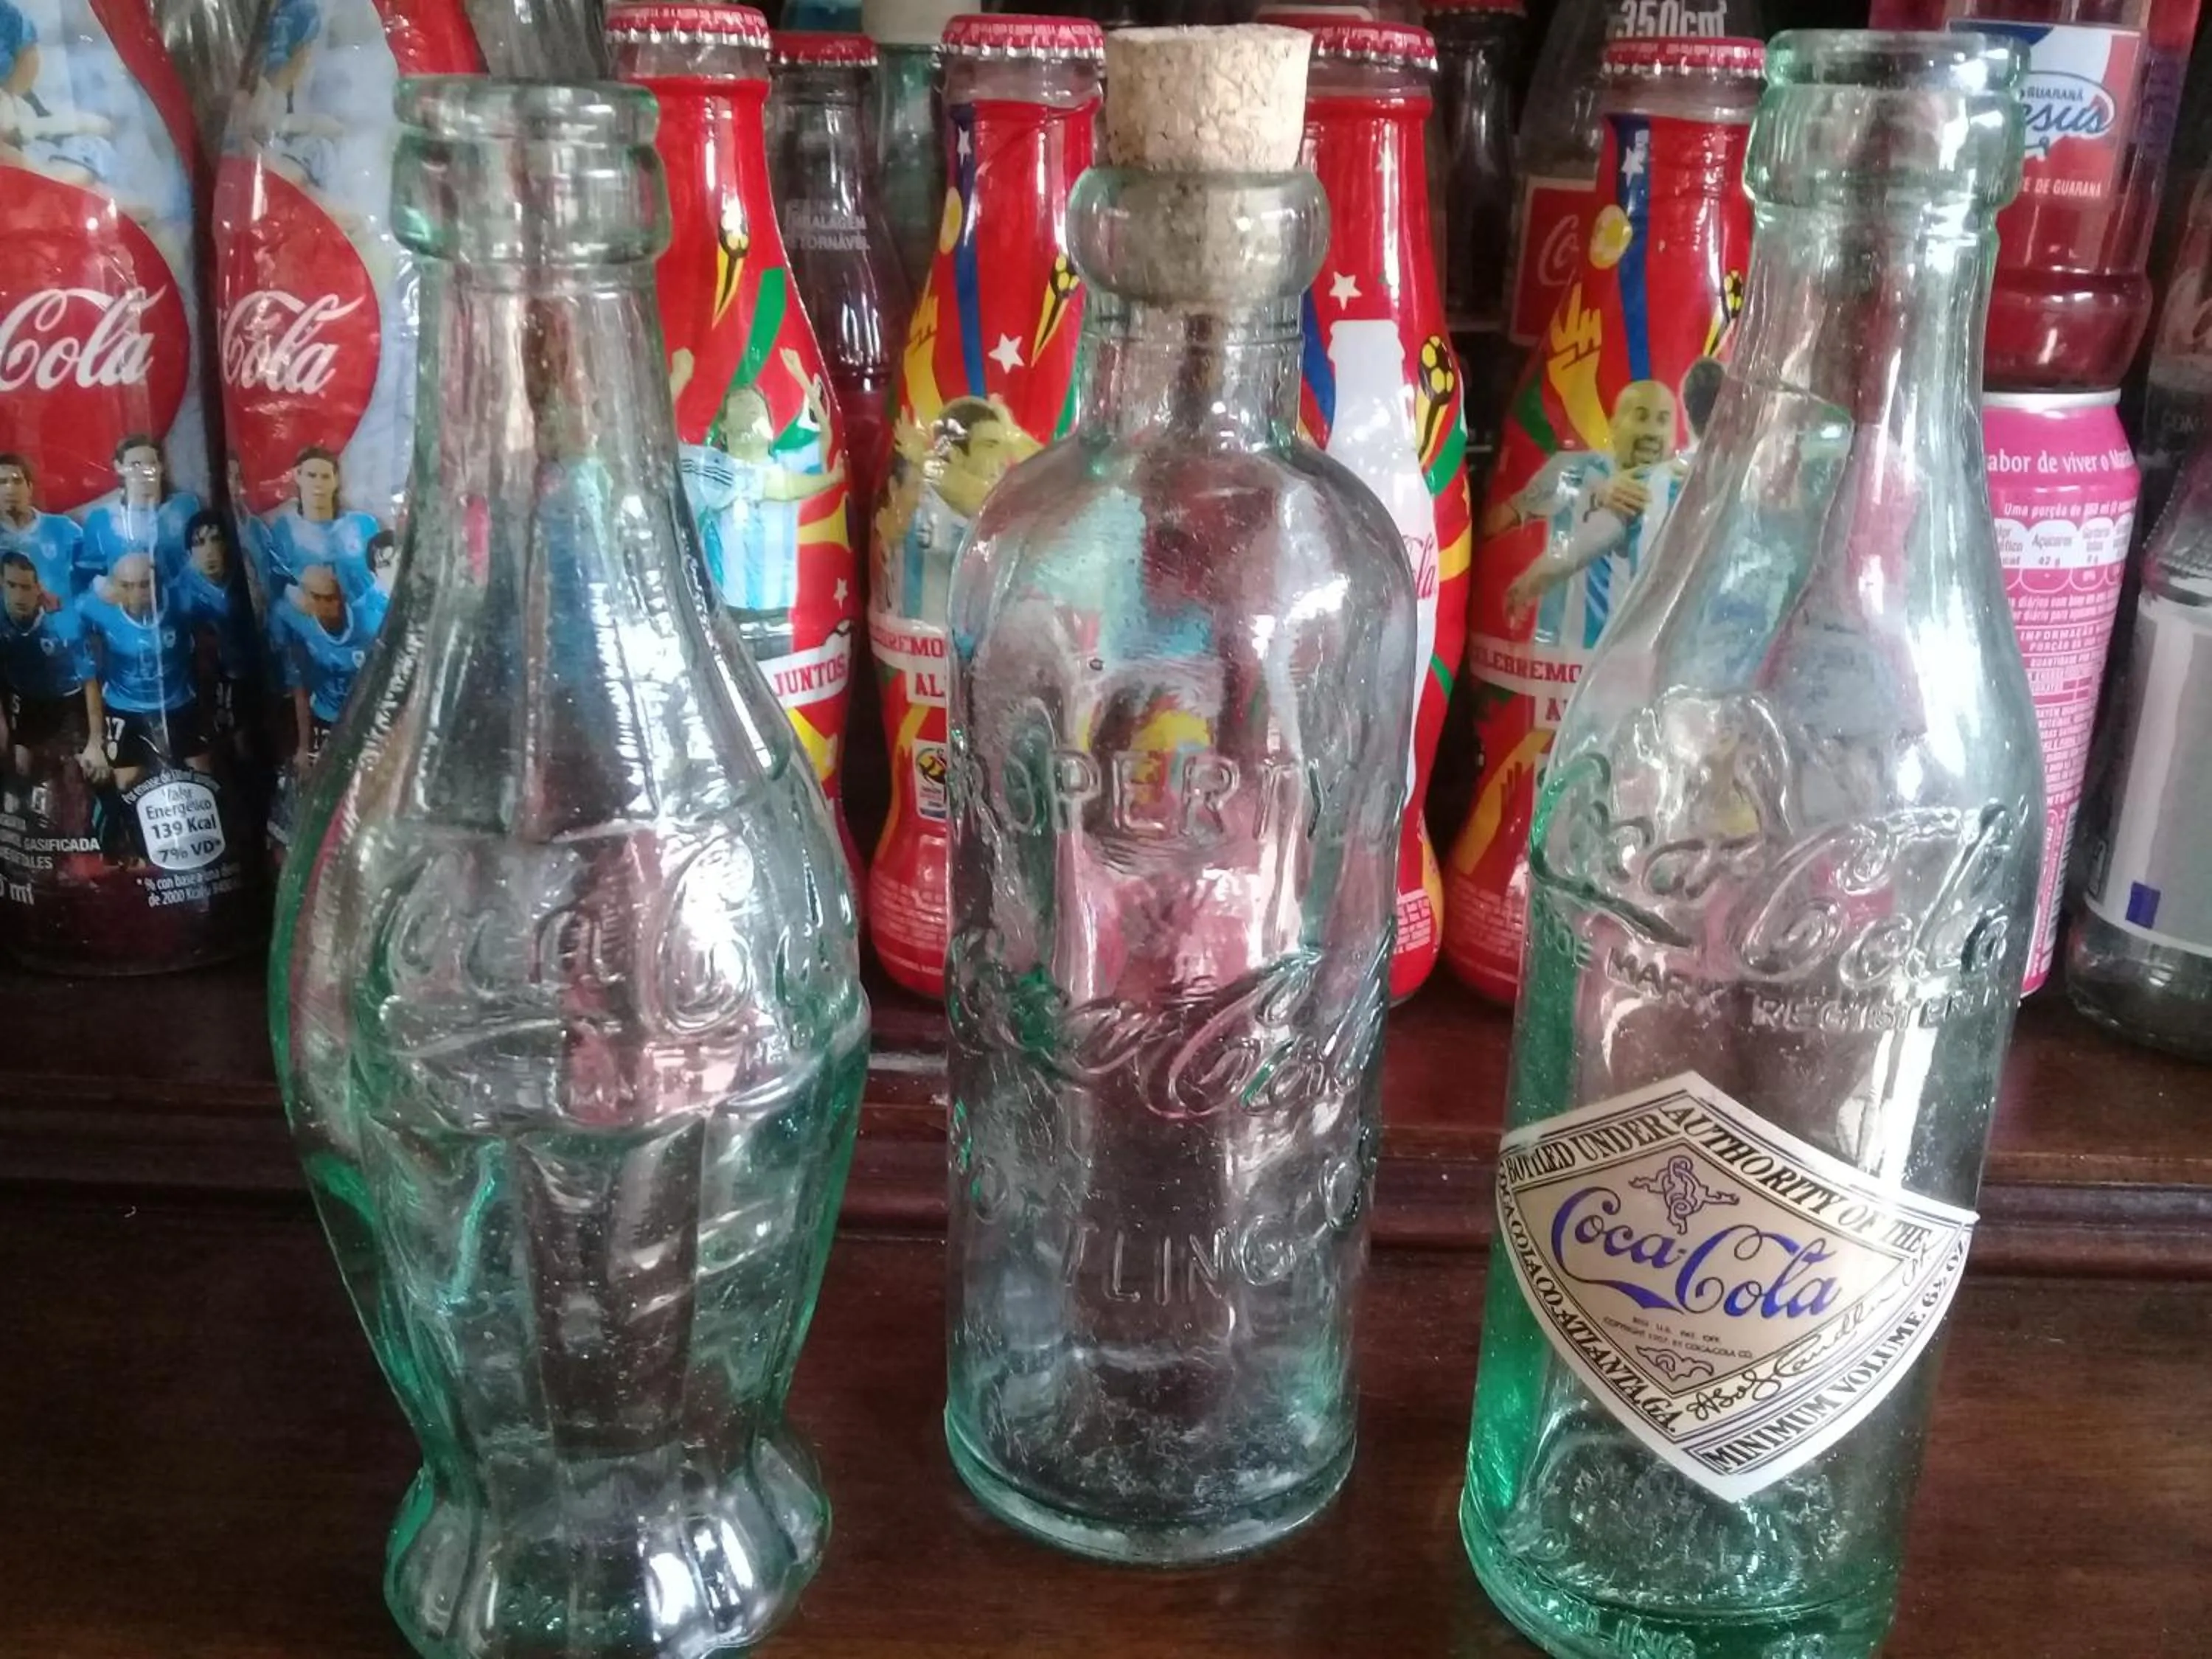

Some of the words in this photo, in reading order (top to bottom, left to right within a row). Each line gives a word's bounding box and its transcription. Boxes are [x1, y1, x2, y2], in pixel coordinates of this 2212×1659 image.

[2023, 103, 2115, 135] esus
[1986, 448, 2031, 473] abor
[2037, 449, 2059, 473] de
[2062, 451, 2098, 473] viver
[2101, 454, 2110, 471] o
[773, 653, 846, 697] JUNTOS
[151, 820, 184, 840] 139
[187, 813, 218, 835] Kcal
[158, 846, 189, 863] 7%
[1568, 1113, 1681, 1162] UNDER
[1659, 1105, 1849, 1216] AUTHORITY
[1837, 1203, 1885, 1234] OF
[1880, 1218, 1933, 1253] THE
[1701, 1392, 1844, 1473] MINIMUM
[1830, 1310, 1927, 1395] VOLUME
